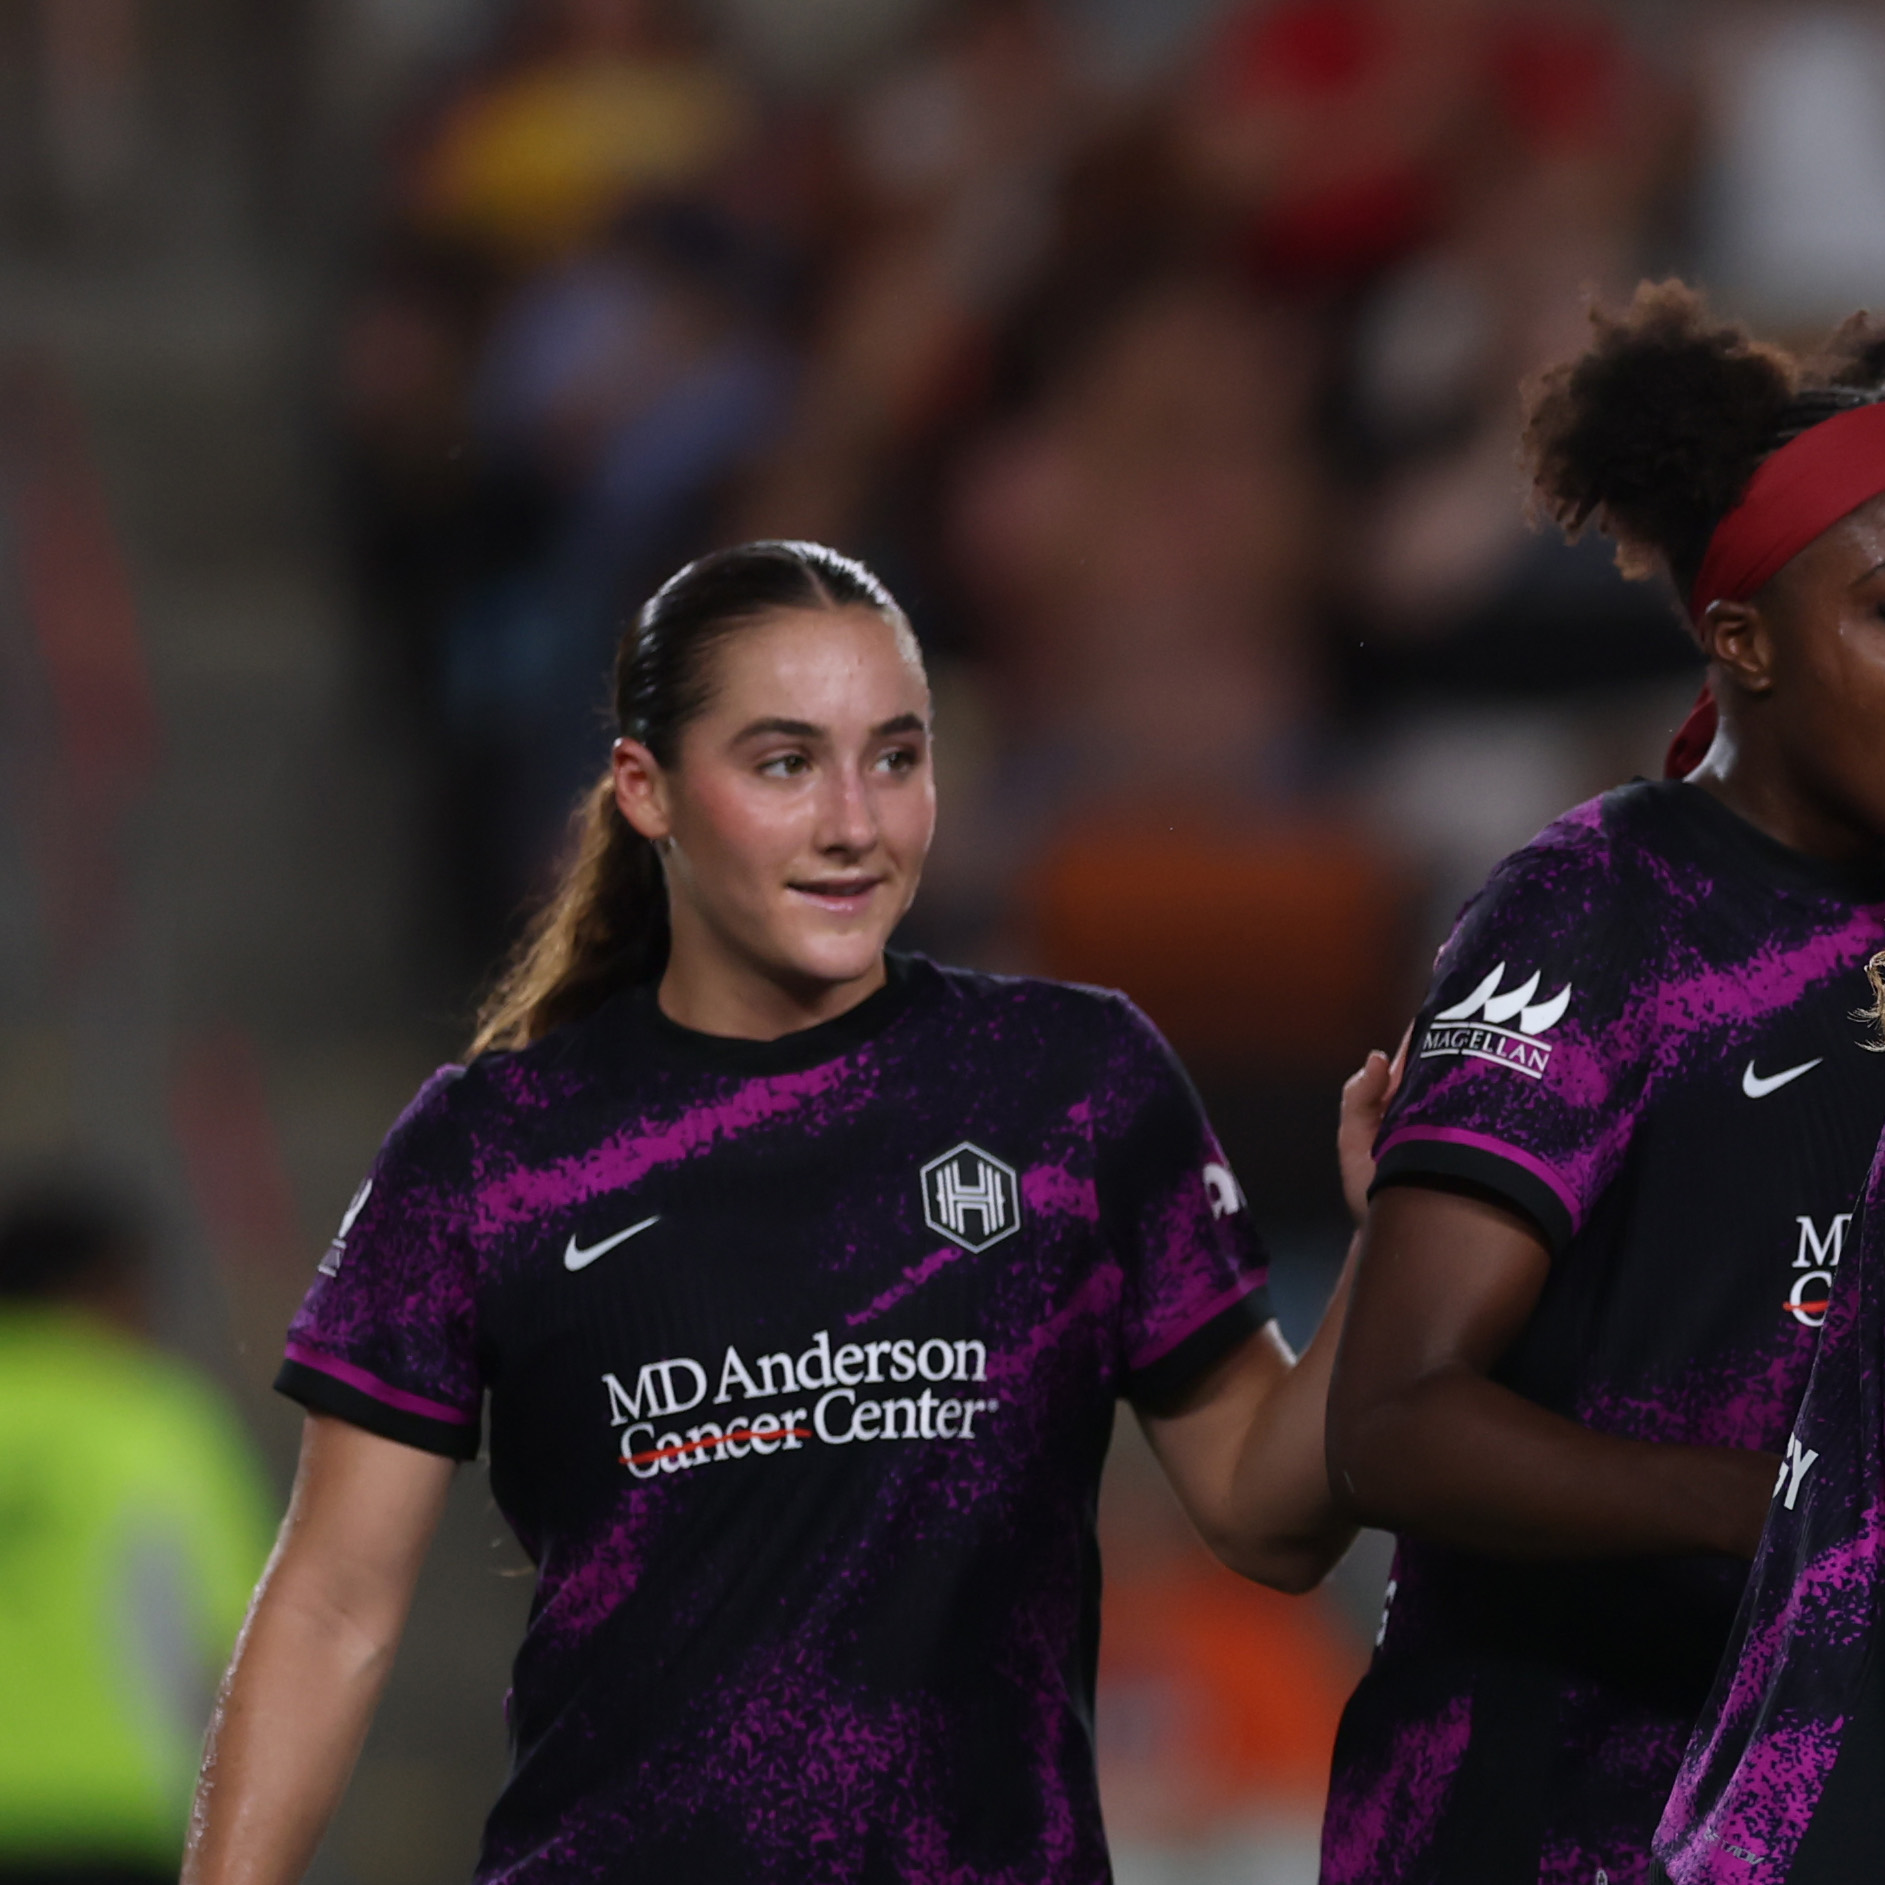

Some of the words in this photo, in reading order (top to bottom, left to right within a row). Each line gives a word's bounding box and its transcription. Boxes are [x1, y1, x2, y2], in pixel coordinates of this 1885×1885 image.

[1423, 1029, 1549, 1072] MAGELLAN
[601, 1356, 708, 1427] MD
[713, 1330, 988, 1405] Anderson
[620, 1408, 808, 1479] Cancer
